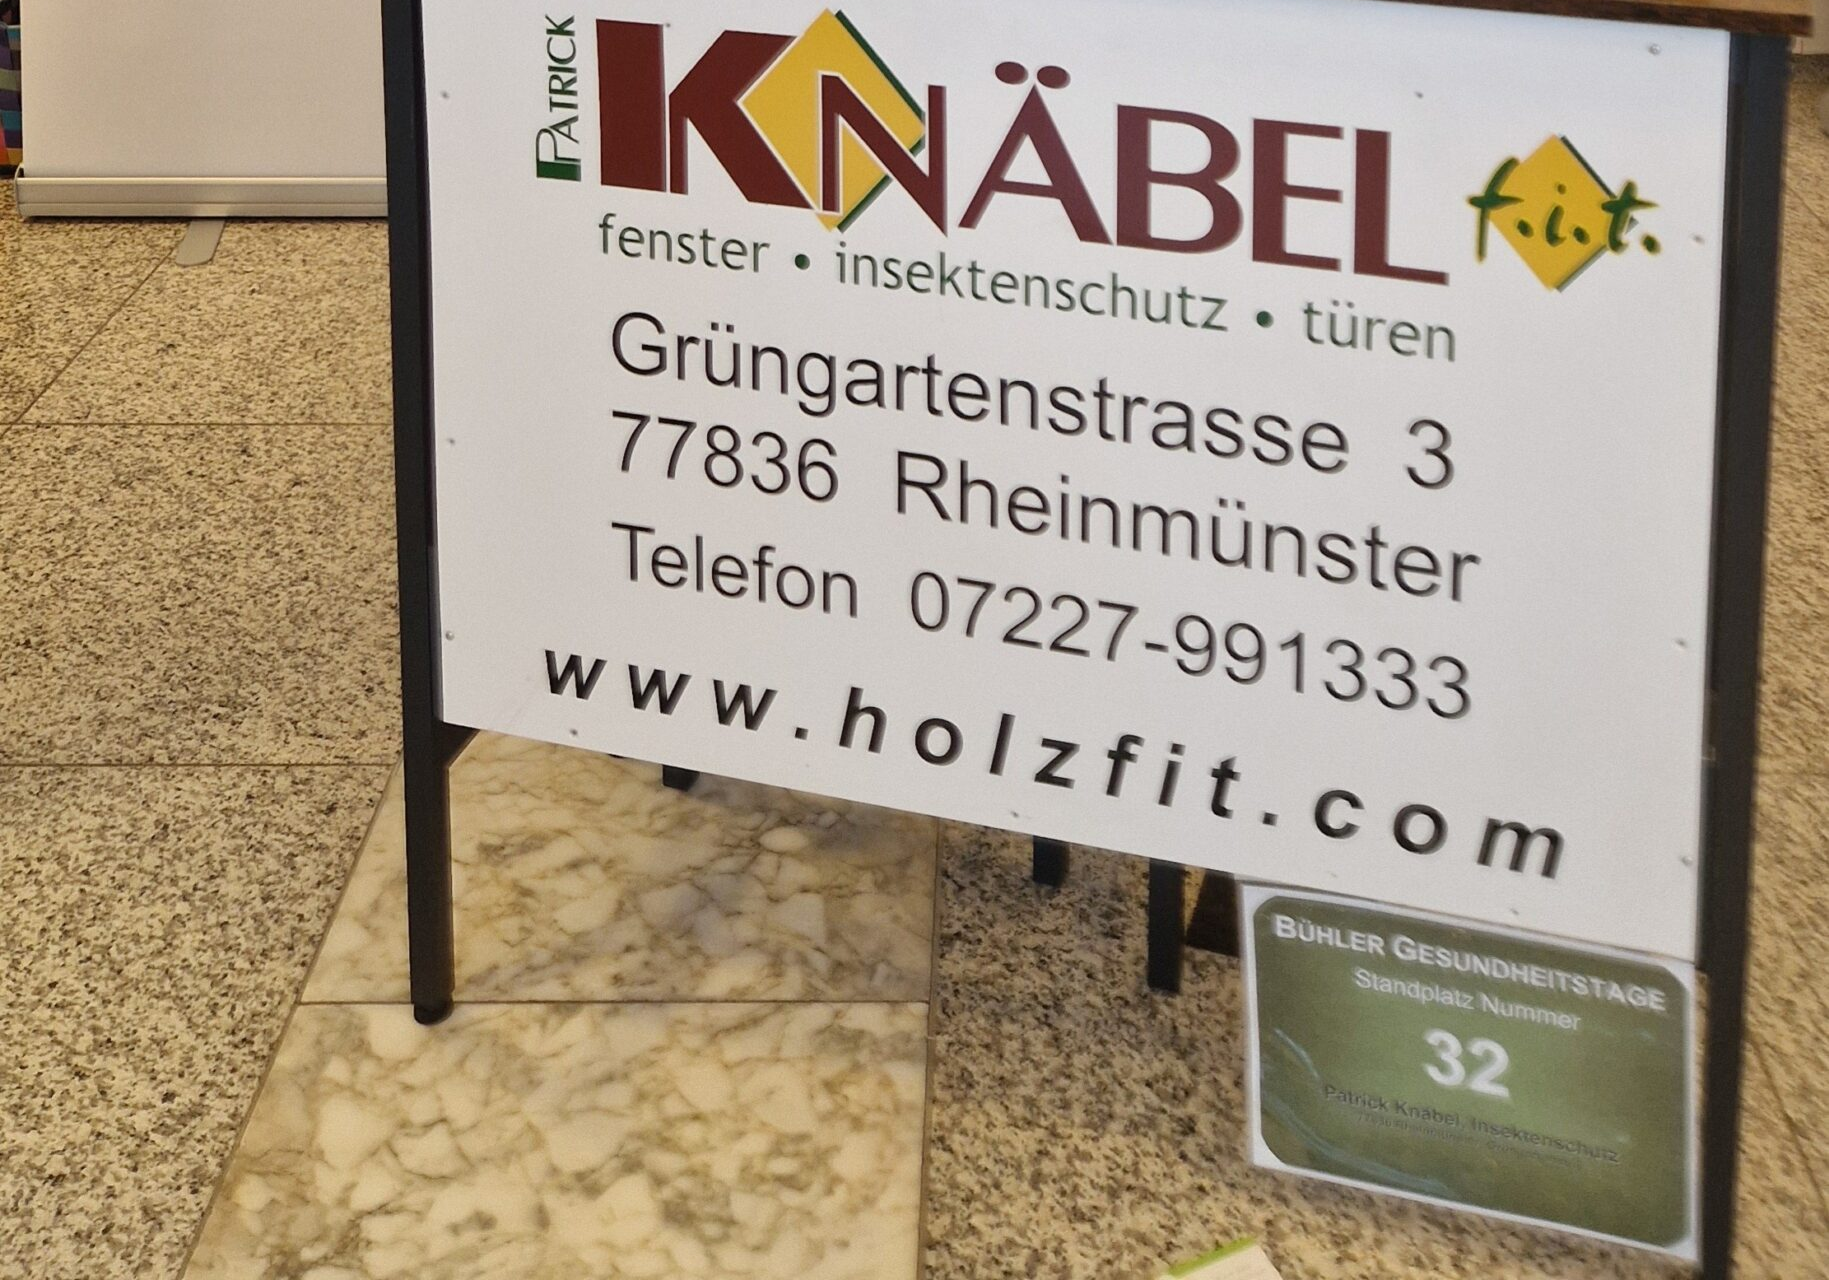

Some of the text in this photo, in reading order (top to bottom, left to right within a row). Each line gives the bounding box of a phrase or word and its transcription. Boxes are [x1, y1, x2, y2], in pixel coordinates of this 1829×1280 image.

[536, 14, 580, 182] PATRICK
[596, 18, 1450, 286] KNÄBEL
[598, 212, 1457, 363] fenster insektenschutz türen
[611, 312, 1455, 491] Grüngartenstrasse 3
[611, 410, 1480, 602] 77836 Rheinmünster
[612, 521, 1472, 721] Telefon 07227-991333
[542, 646, 1567, 880] www.holzfit.com
[1273, 913, 1667, 1013] BÜHLER GESUNDHEITSTAGE
[1353, 966, 1582, 1032] Standplatz Nummer
[1323, 1085, 1388, 1113] Patrick
[1422, 1027, 1512, 1100] 32
